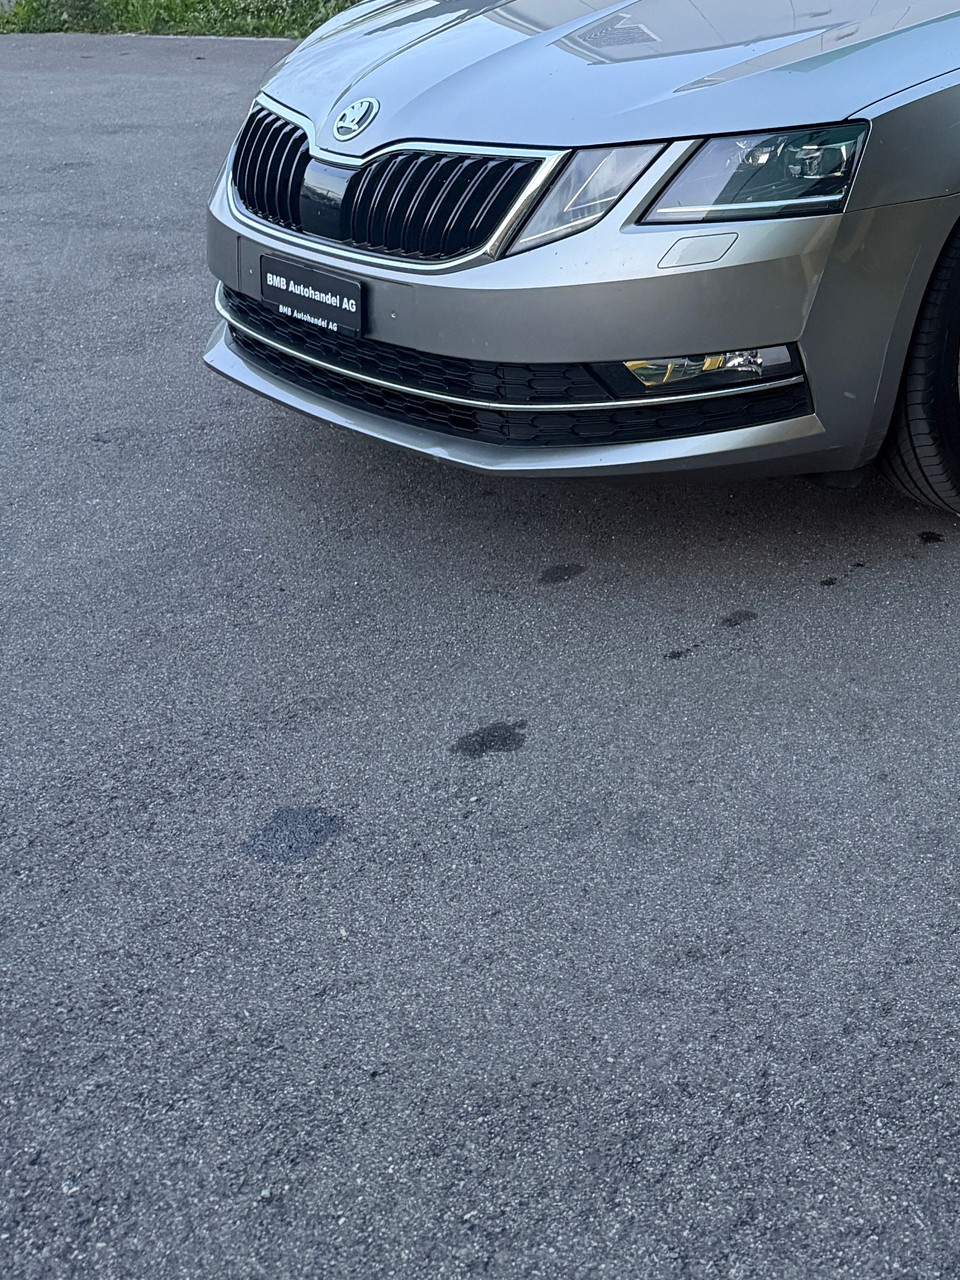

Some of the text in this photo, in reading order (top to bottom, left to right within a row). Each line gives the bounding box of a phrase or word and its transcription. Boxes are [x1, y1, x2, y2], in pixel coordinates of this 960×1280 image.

[267, 273, 357, 312] BMB Autohandel AG
[279, 305, 338, 332] BMB Autohandel AG
